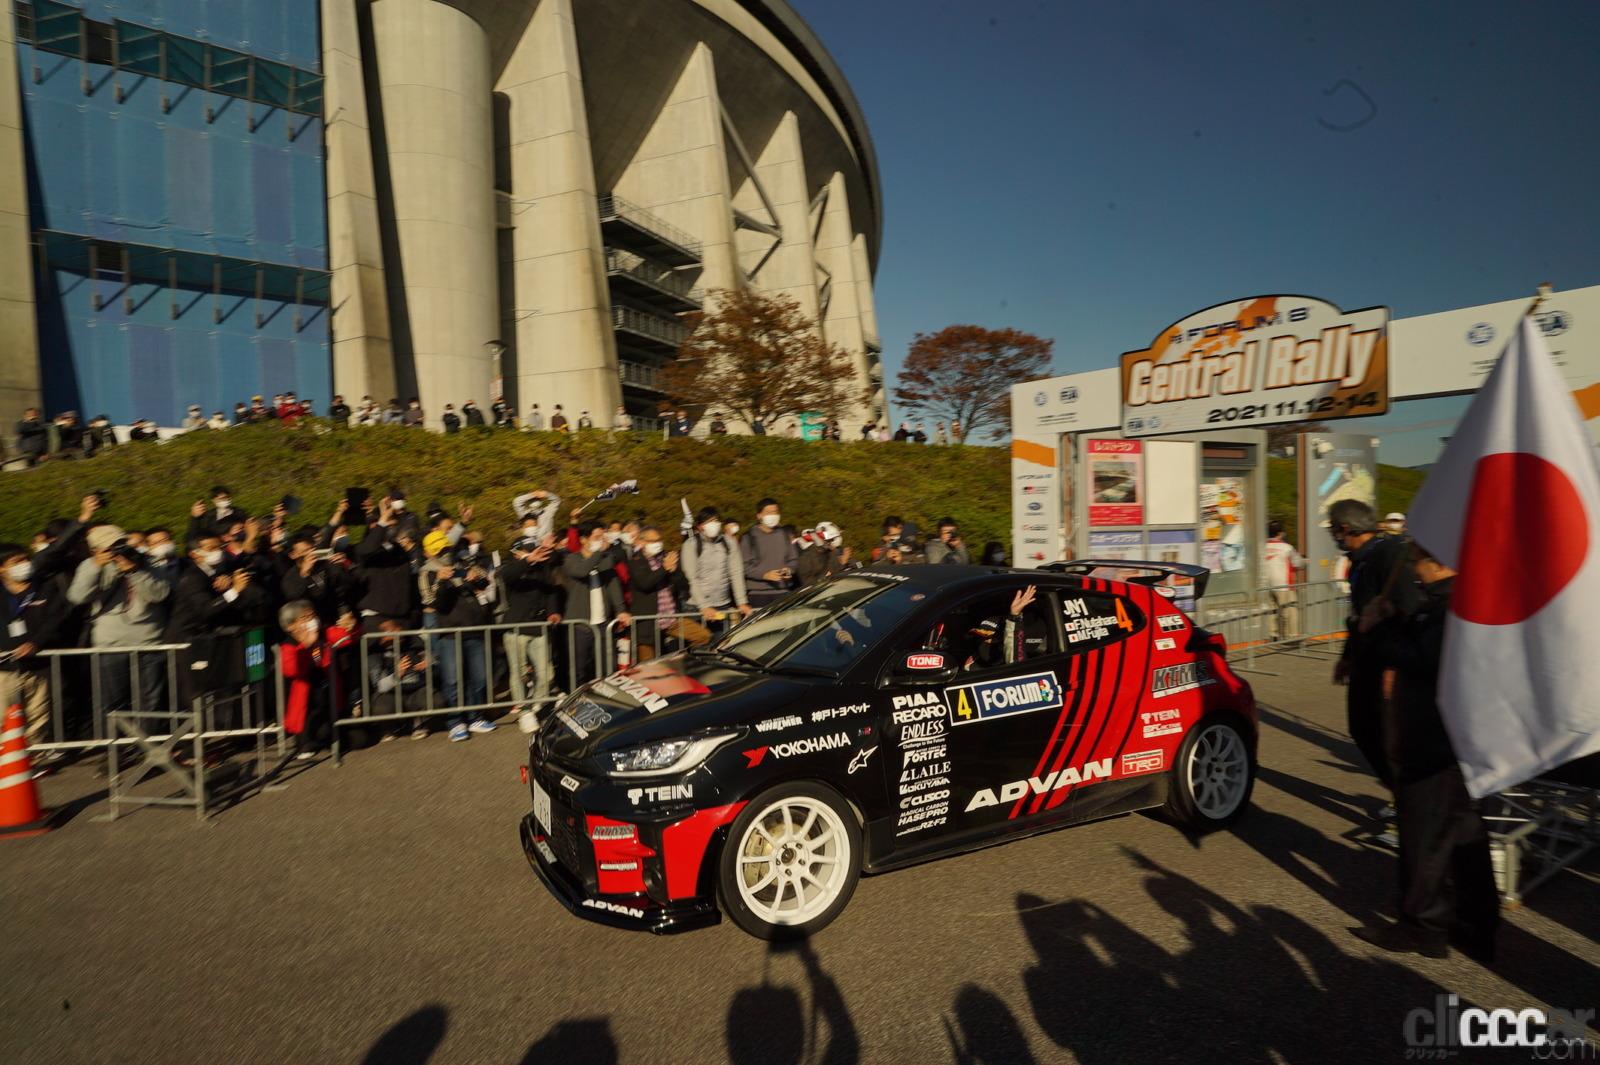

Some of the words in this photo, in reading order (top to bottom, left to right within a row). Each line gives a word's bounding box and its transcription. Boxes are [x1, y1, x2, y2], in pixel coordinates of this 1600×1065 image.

[1127, 340, 1259, 407] Central
[1264, 324, 1381, 390] Rally
[1207, 402, 1268, 424] 2021
[1275, 391, 1379, 415] 11.12-14
[1063, 597, 1089, 616] JN1
[1115, 597, 1133, 632] 4
[910, 655, 942, 667] TONE
[892, 691, 940, 710] PIAA
[957, 687, 972, 720] 4
[981, 679, 1055, 711] FORUM8
[811, 702, 871, 723] 神戸トヨペット
[892, 704, 947, 725] RECARO
[900, 719, 945, 741] ENDLESS
[768, 731, 852, 760] YOKOHAMA
[903, 747, 947, 770] FORTEC
[910, 760, 952, 780] LAILE
[644, 783, 694, 802] TEIN
[963, 757, 1113, 813] ADVAN
[910, 788, 951, 806] CUSCO
[898, 806, 949, 827] HASEPRO
[582, 898, 645, 919] ADVAN
